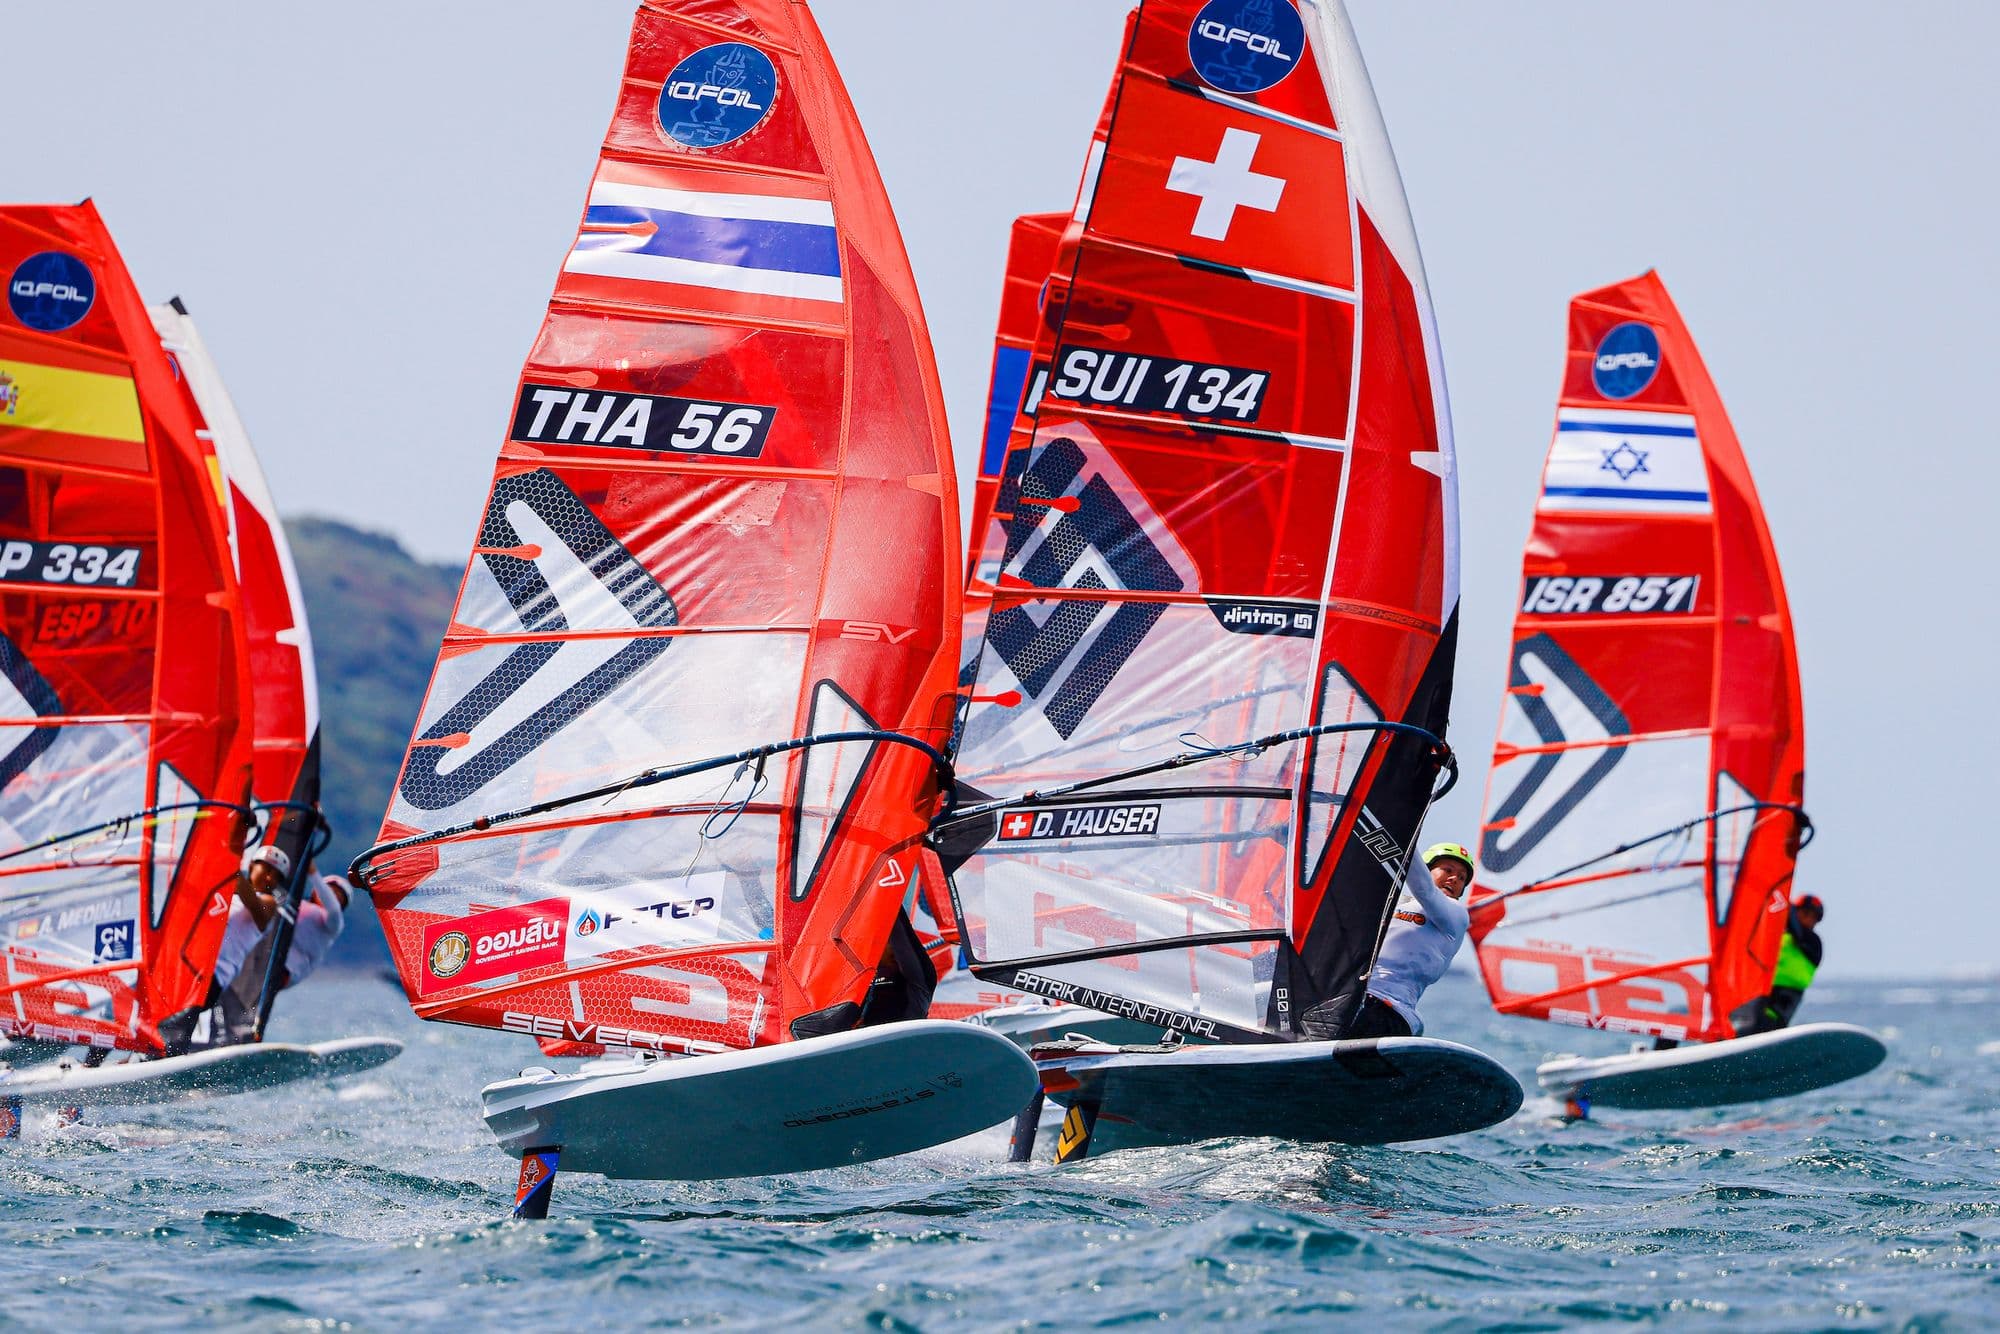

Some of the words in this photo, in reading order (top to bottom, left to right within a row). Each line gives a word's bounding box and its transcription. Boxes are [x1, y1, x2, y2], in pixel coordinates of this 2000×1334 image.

[1055, 349, 1152, 404] SUI
[1163, 364, 1266, 419] 134
[526, 388, 654, 446] THA
[670, 404, 761, 452] 56
[0, 541, 33, 579] P
[42, 544, 140, 586] 334
[1521, 577, 1605, 613] ISR
[1602, 576, 1694, 613] 851
[38, 602, 102, 641] ESP
[1031, 812, 1054, 837] D.
[1060, 806, 1159, 836] HAUSER
[475, 950, 515, 965] GOVERNMENT
[515, 944, 541, 956] SAVINGS
[541, 941, 559, 950] BANK
[476, 916, 560, 956] ออมสิน
[1012, 971, 1079, 1002] PATRIK
[1081, 989, 1221, 1041] INTERNATIONAL
